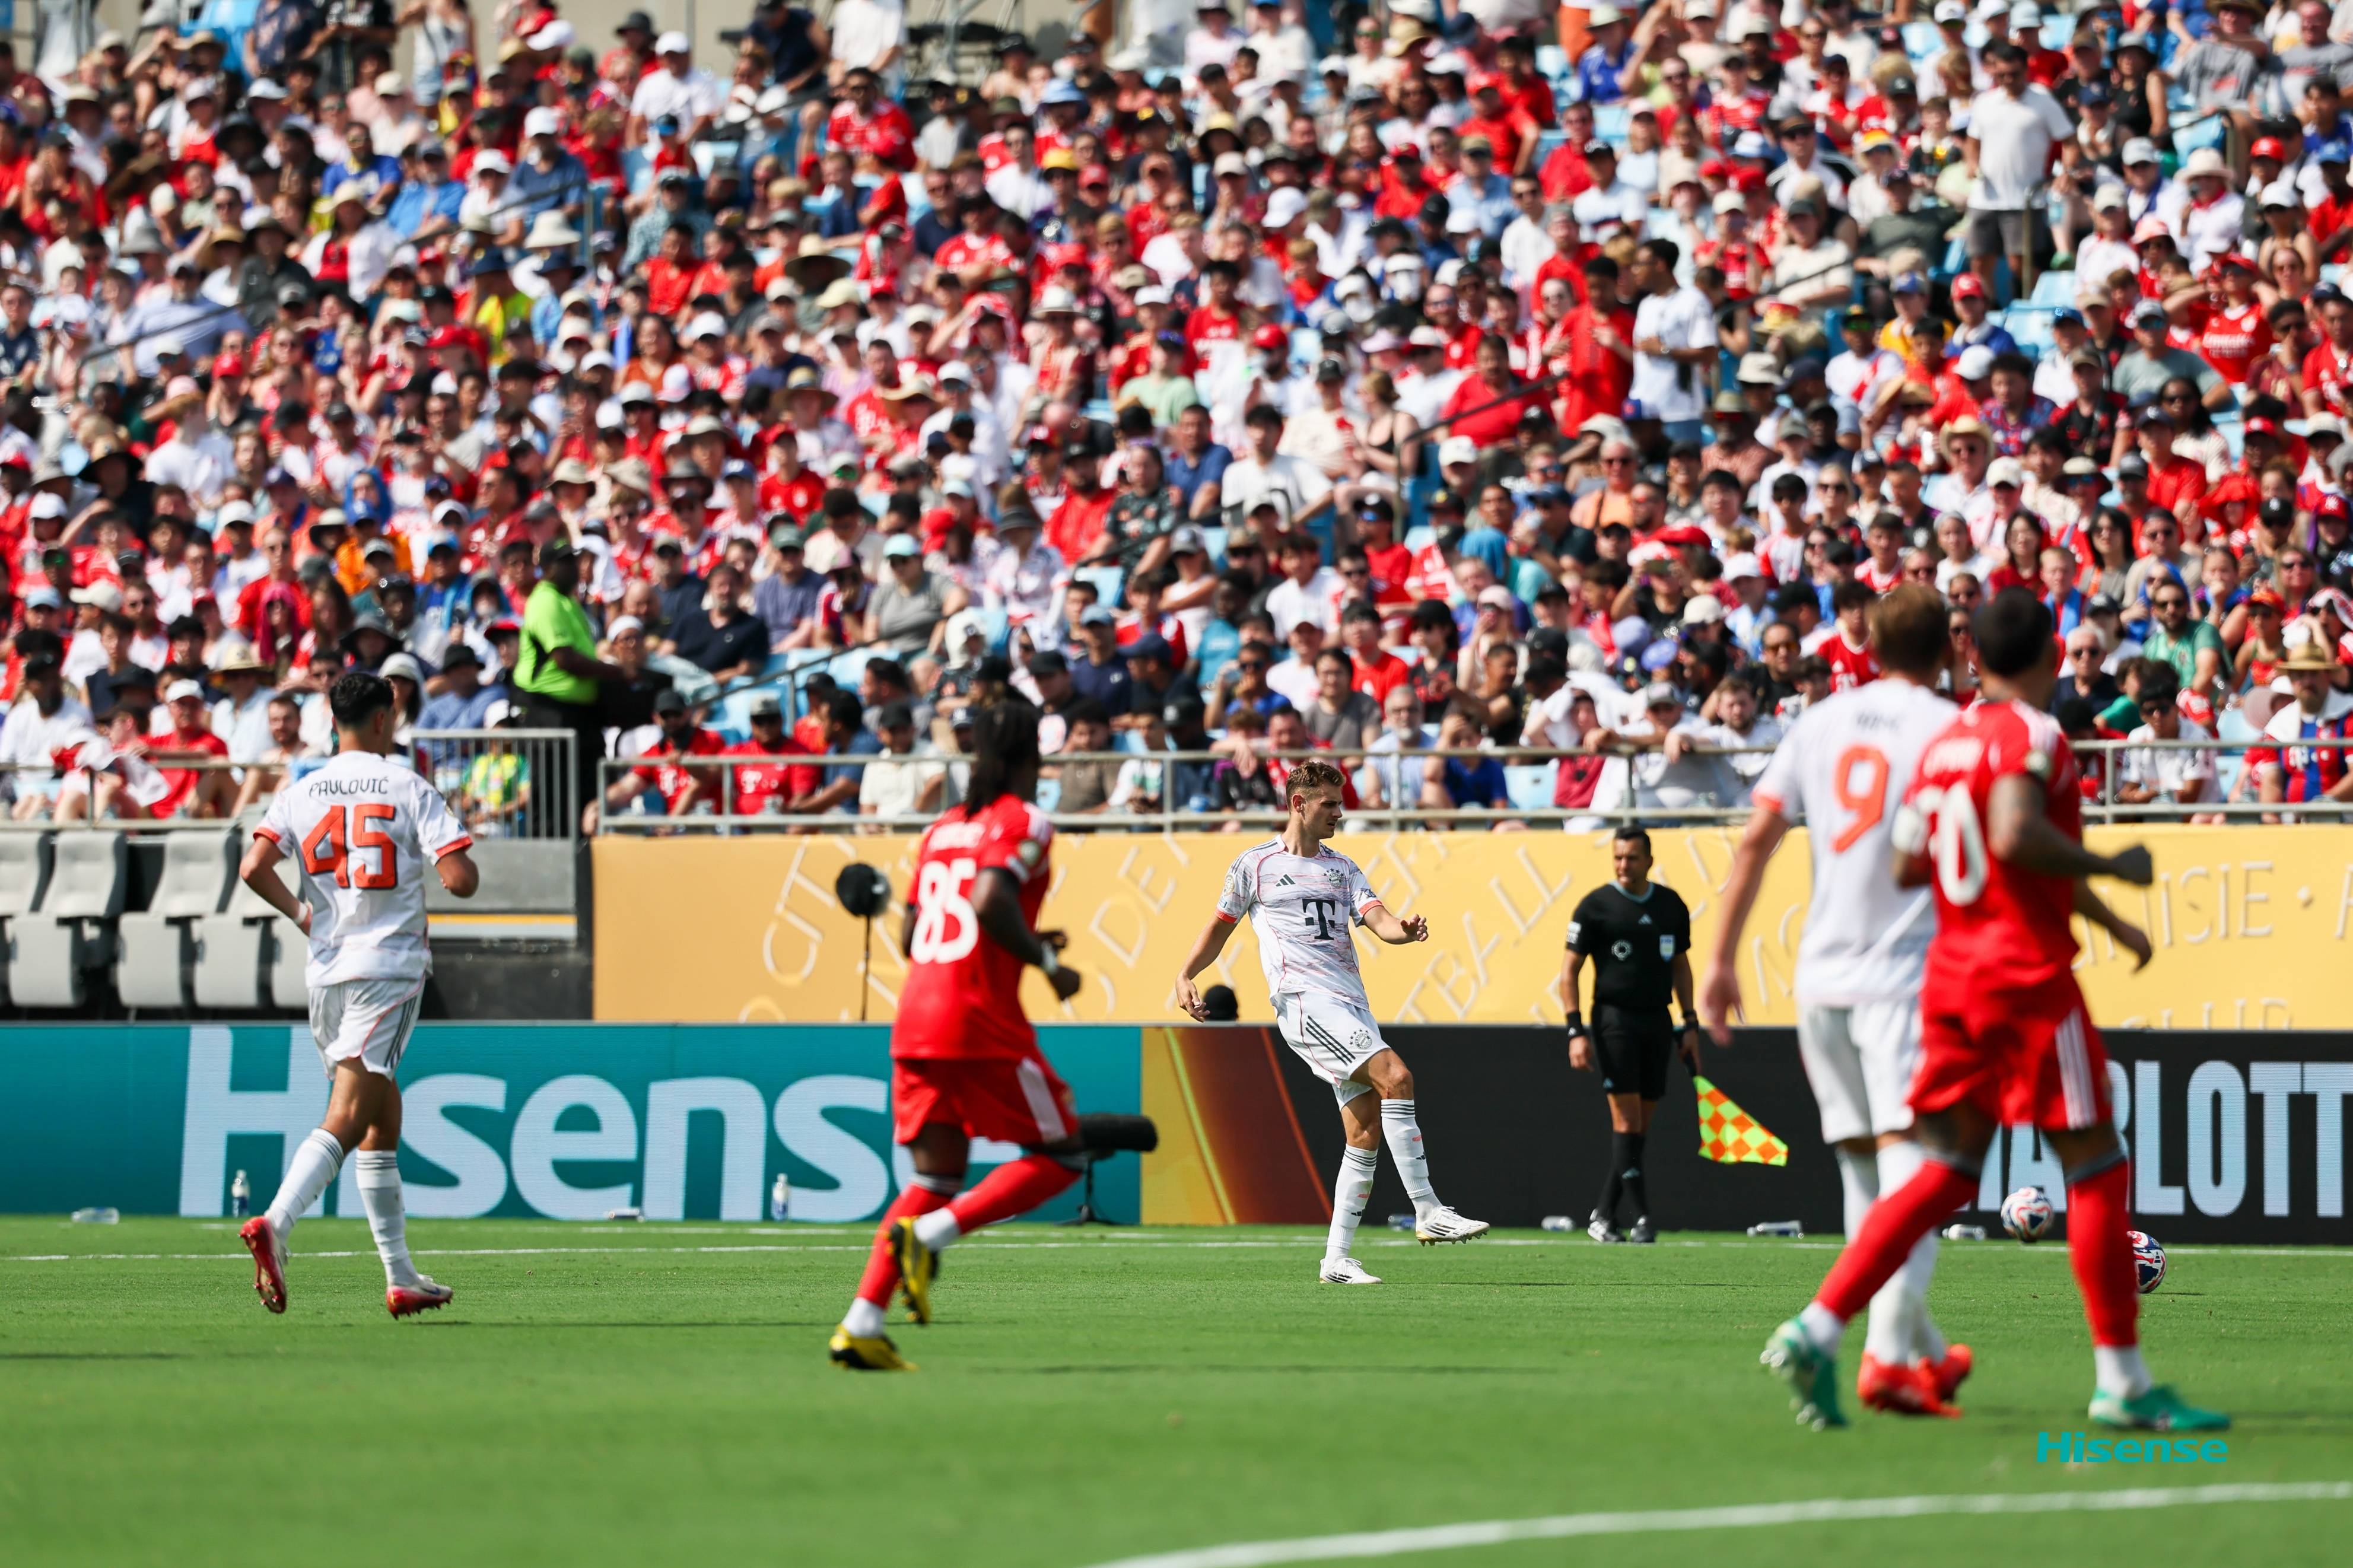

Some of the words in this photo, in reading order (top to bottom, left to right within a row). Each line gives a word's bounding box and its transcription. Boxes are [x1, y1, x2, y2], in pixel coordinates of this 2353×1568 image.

[309, 777, 389, 797] PAVLOVIĆ
[1832, 746, 1889, 853] 9
[301, 804, 398, 890] 45
[1916, 781, 1989, 907] 0
[910, 857, 979, 965] 85
[1302, 898, 1336, 941] T
[180, 1025, 1024, 1222] Hsens
